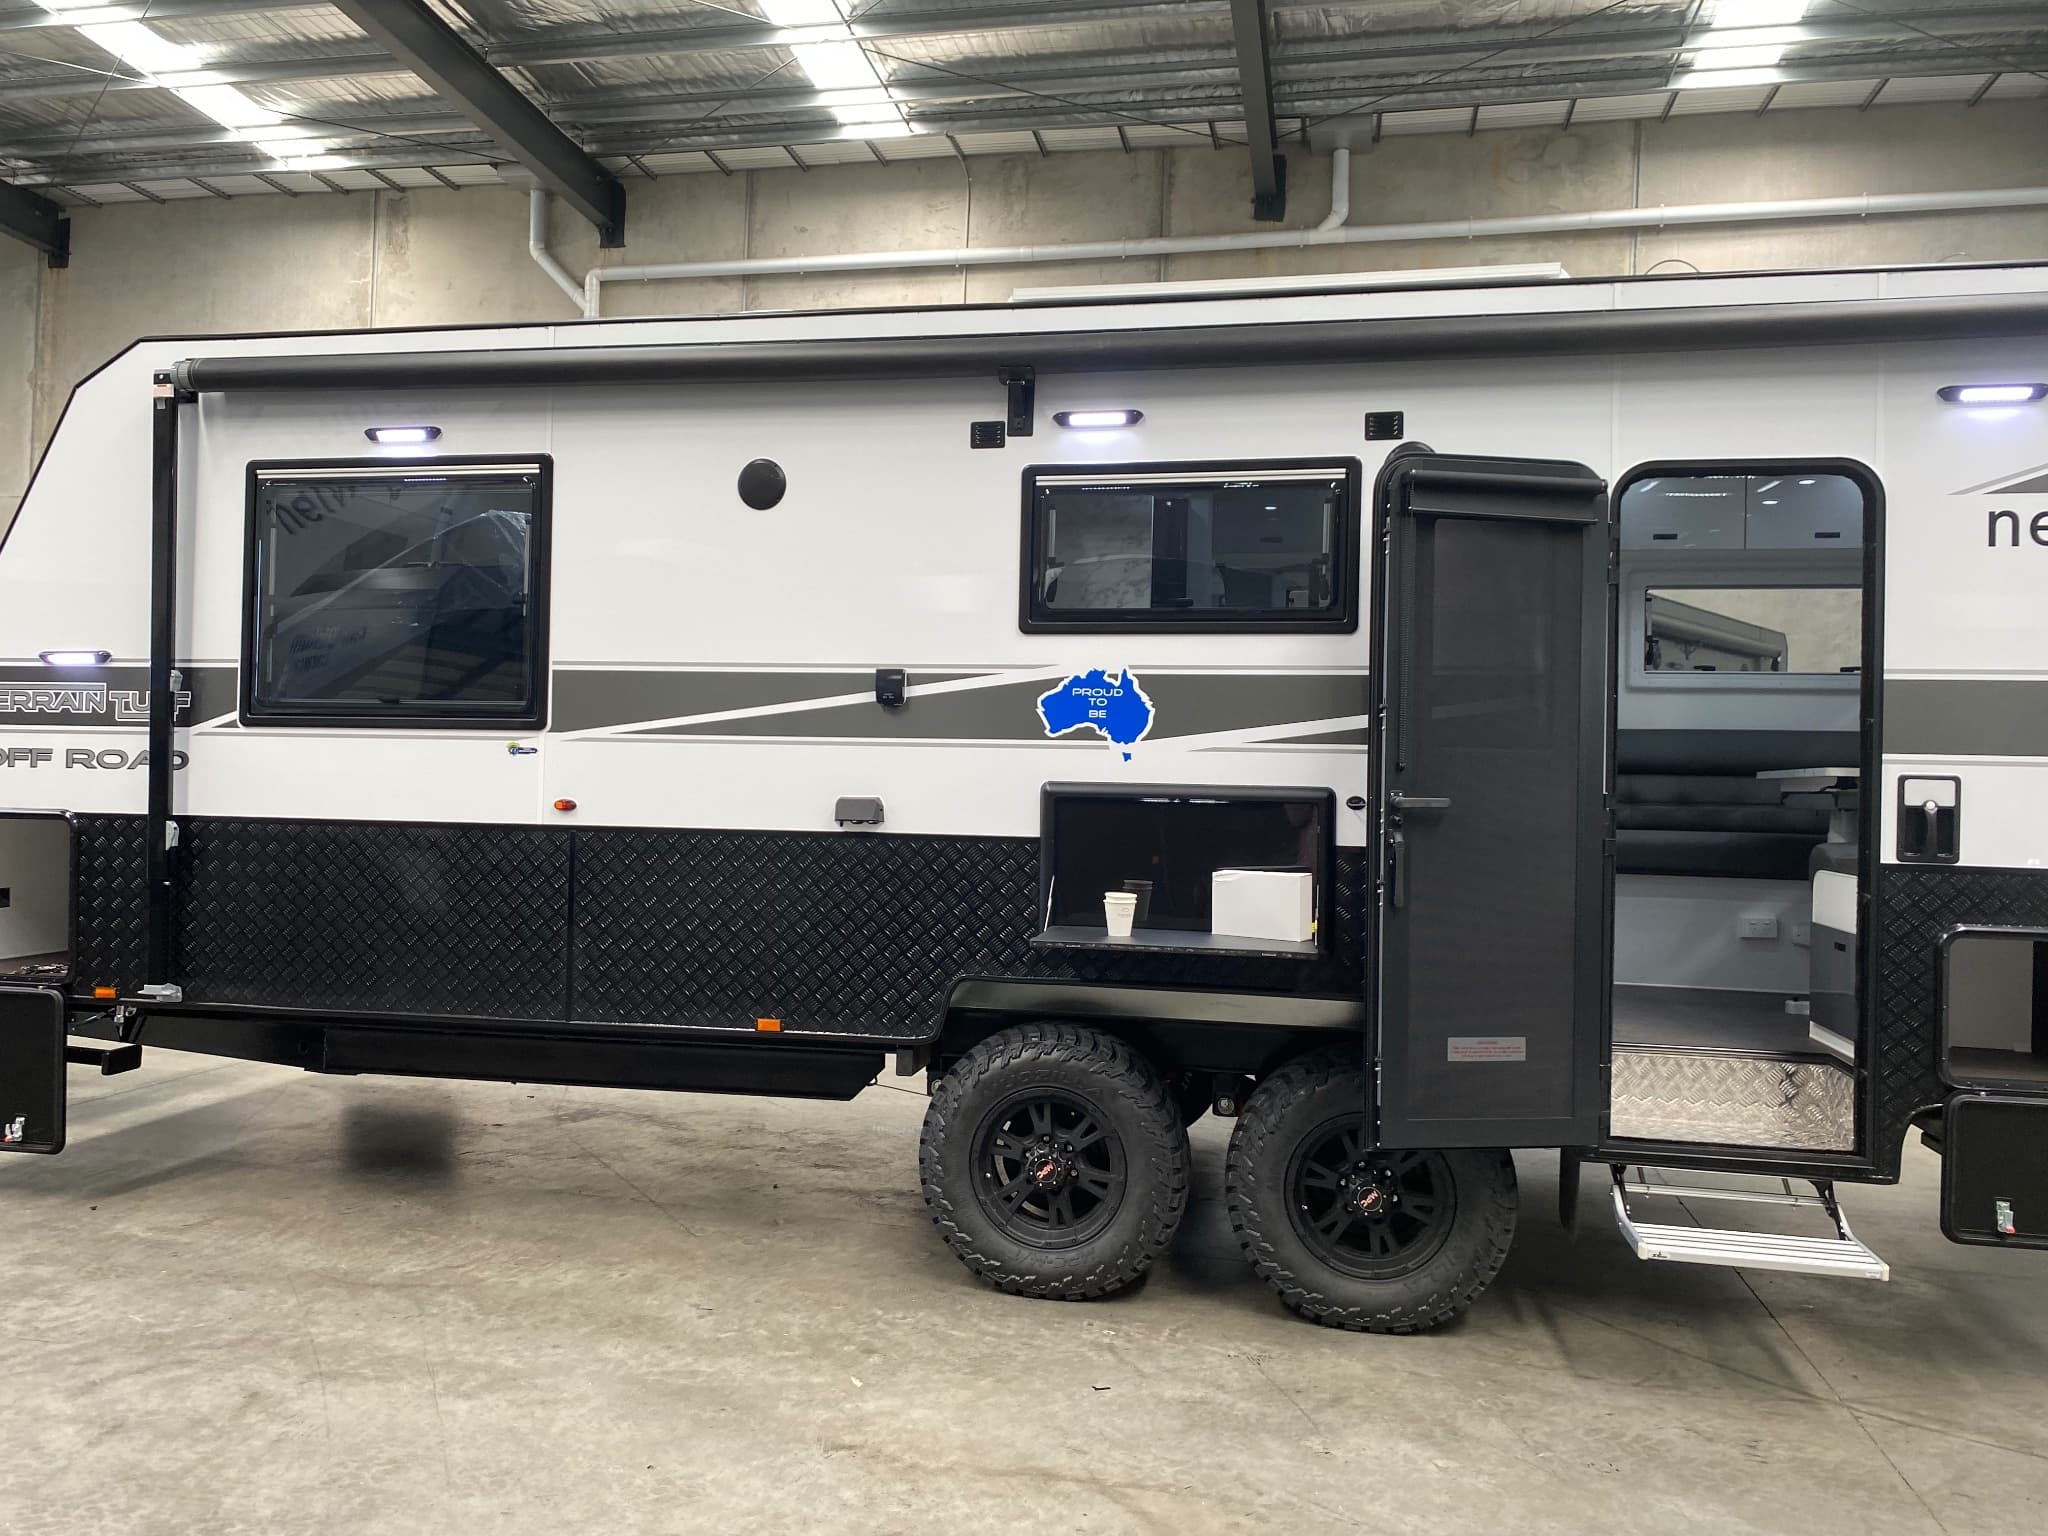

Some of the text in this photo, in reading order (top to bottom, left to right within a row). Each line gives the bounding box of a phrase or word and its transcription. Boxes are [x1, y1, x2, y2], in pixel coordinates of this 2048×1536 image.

[1072, 688, 1123, 697] PROUD
[0, 683, 192, 721] ERRAIN TUF
[1088, 698, 1108, 706] TO
[1088, 710, 1107, 719] BE
[0, 748, 53, 768] FF
